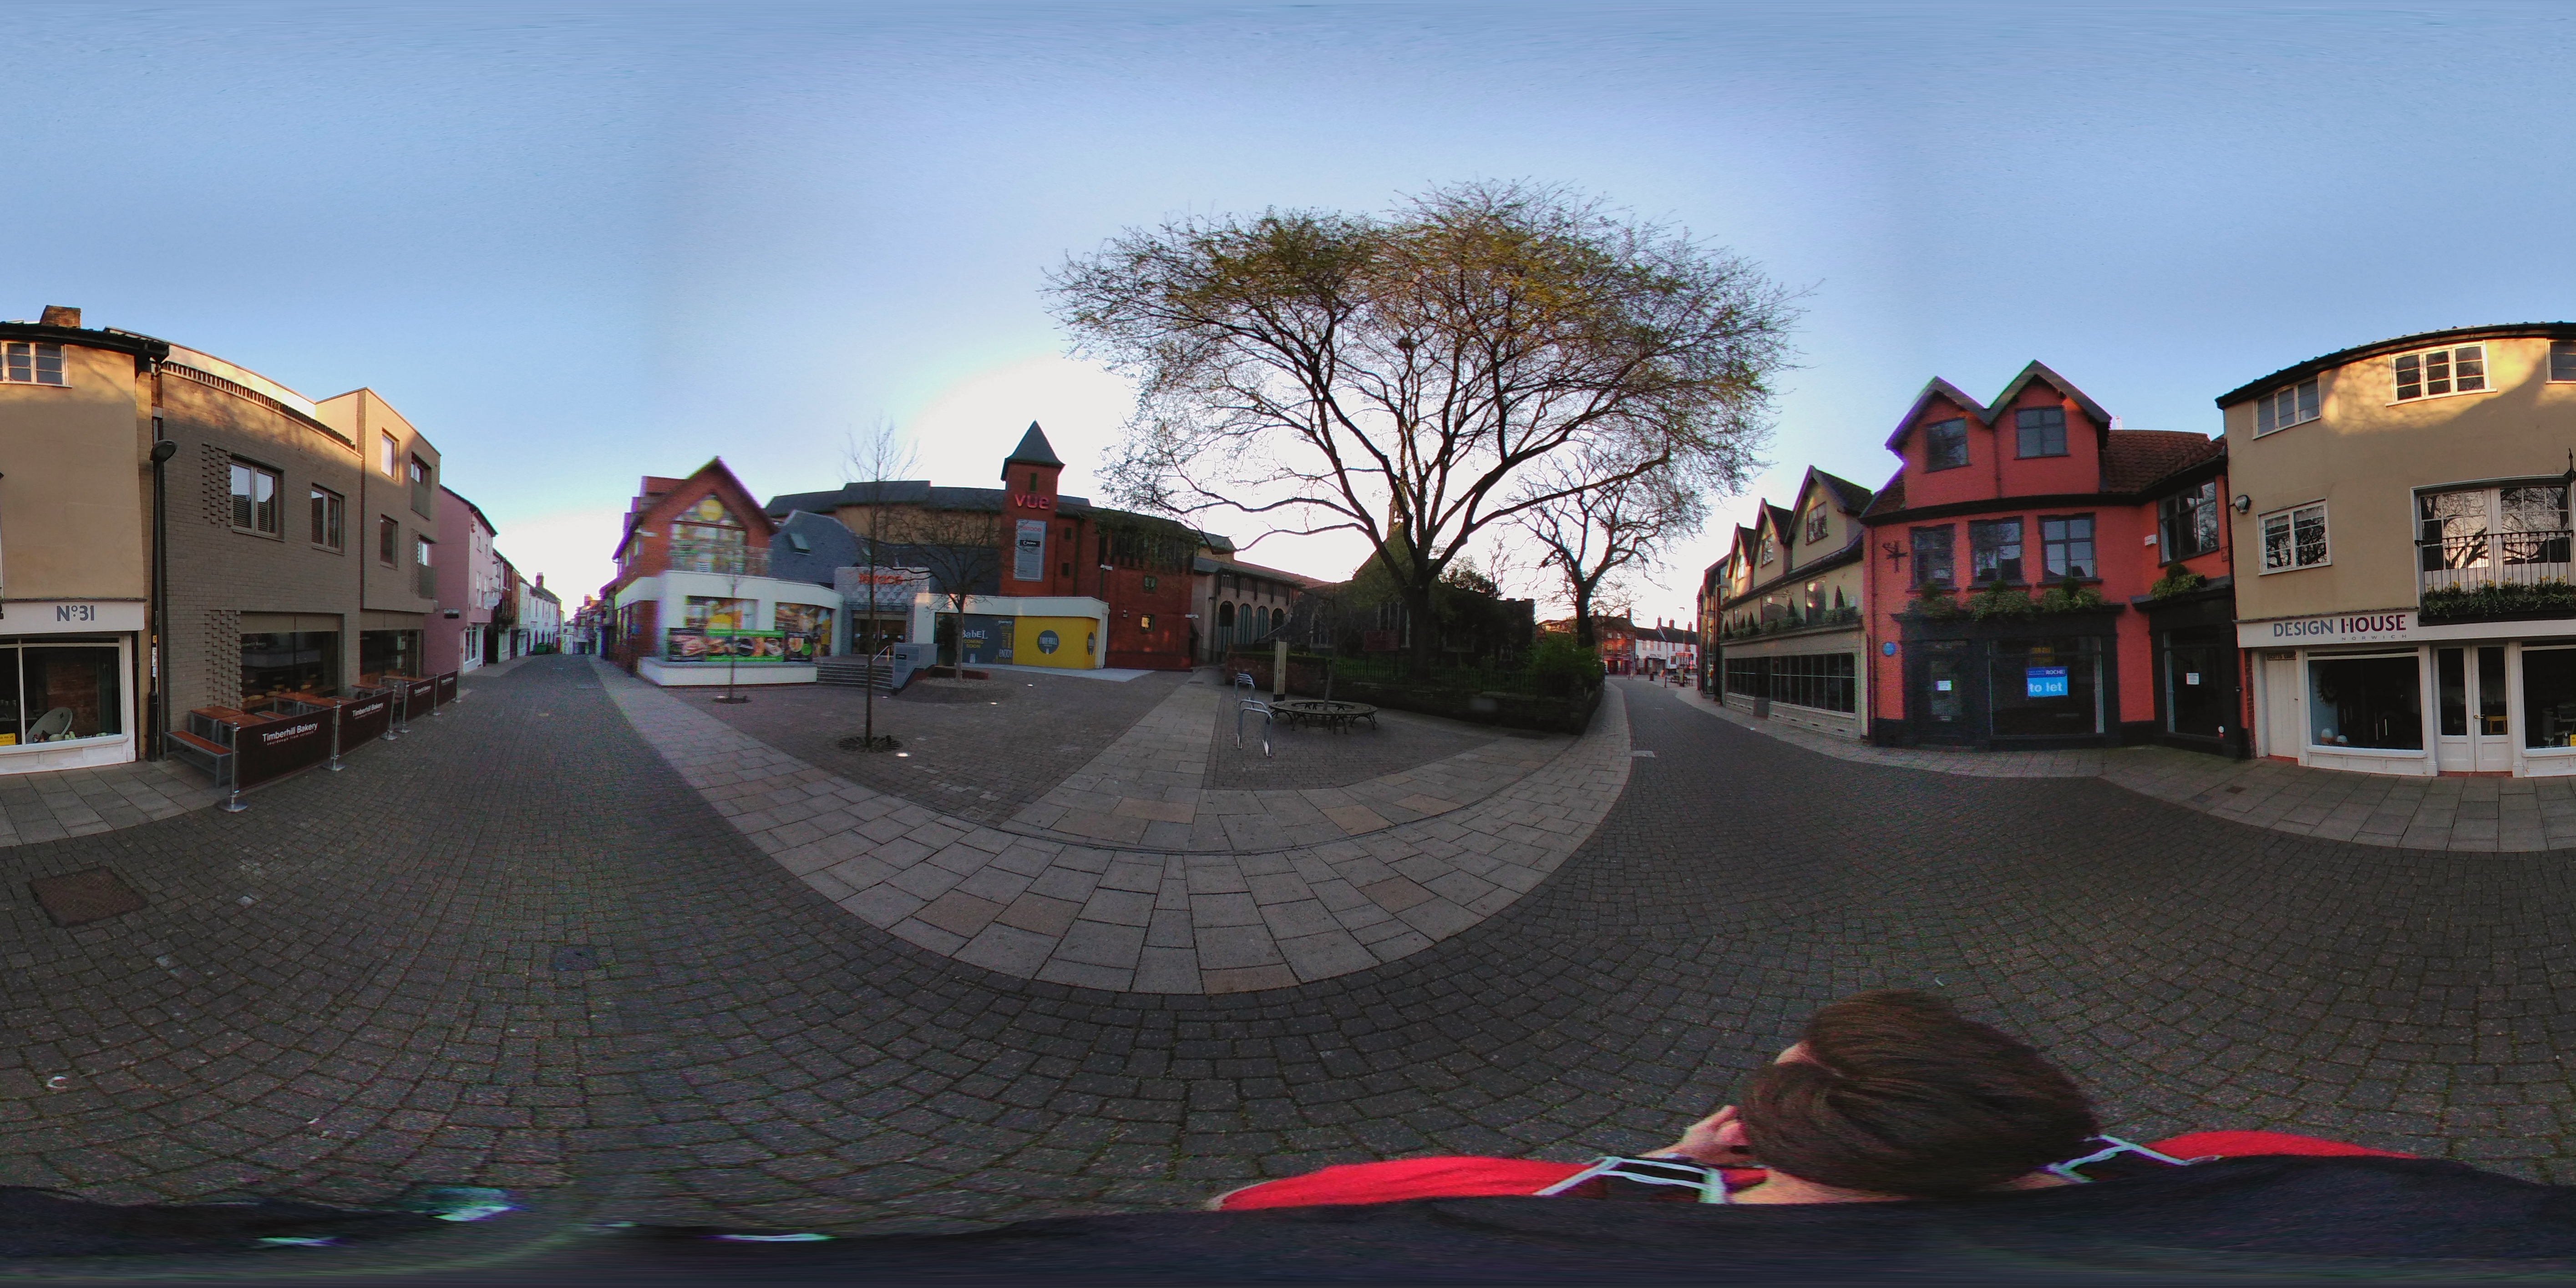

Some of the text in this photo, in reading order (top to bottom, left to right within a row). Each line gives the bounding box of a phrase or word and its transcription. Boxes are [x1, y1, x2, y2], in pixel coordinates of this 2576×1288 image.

[1015, 494, 1050, 509] vue
[2273, 614, 2407, 637] DESIGN HOUSE
[999, 649, 1012, 658] ENJOY
[2029, 682, 2062, 692] to let
[262, 722, 318, 742] Timberhill Bakery
